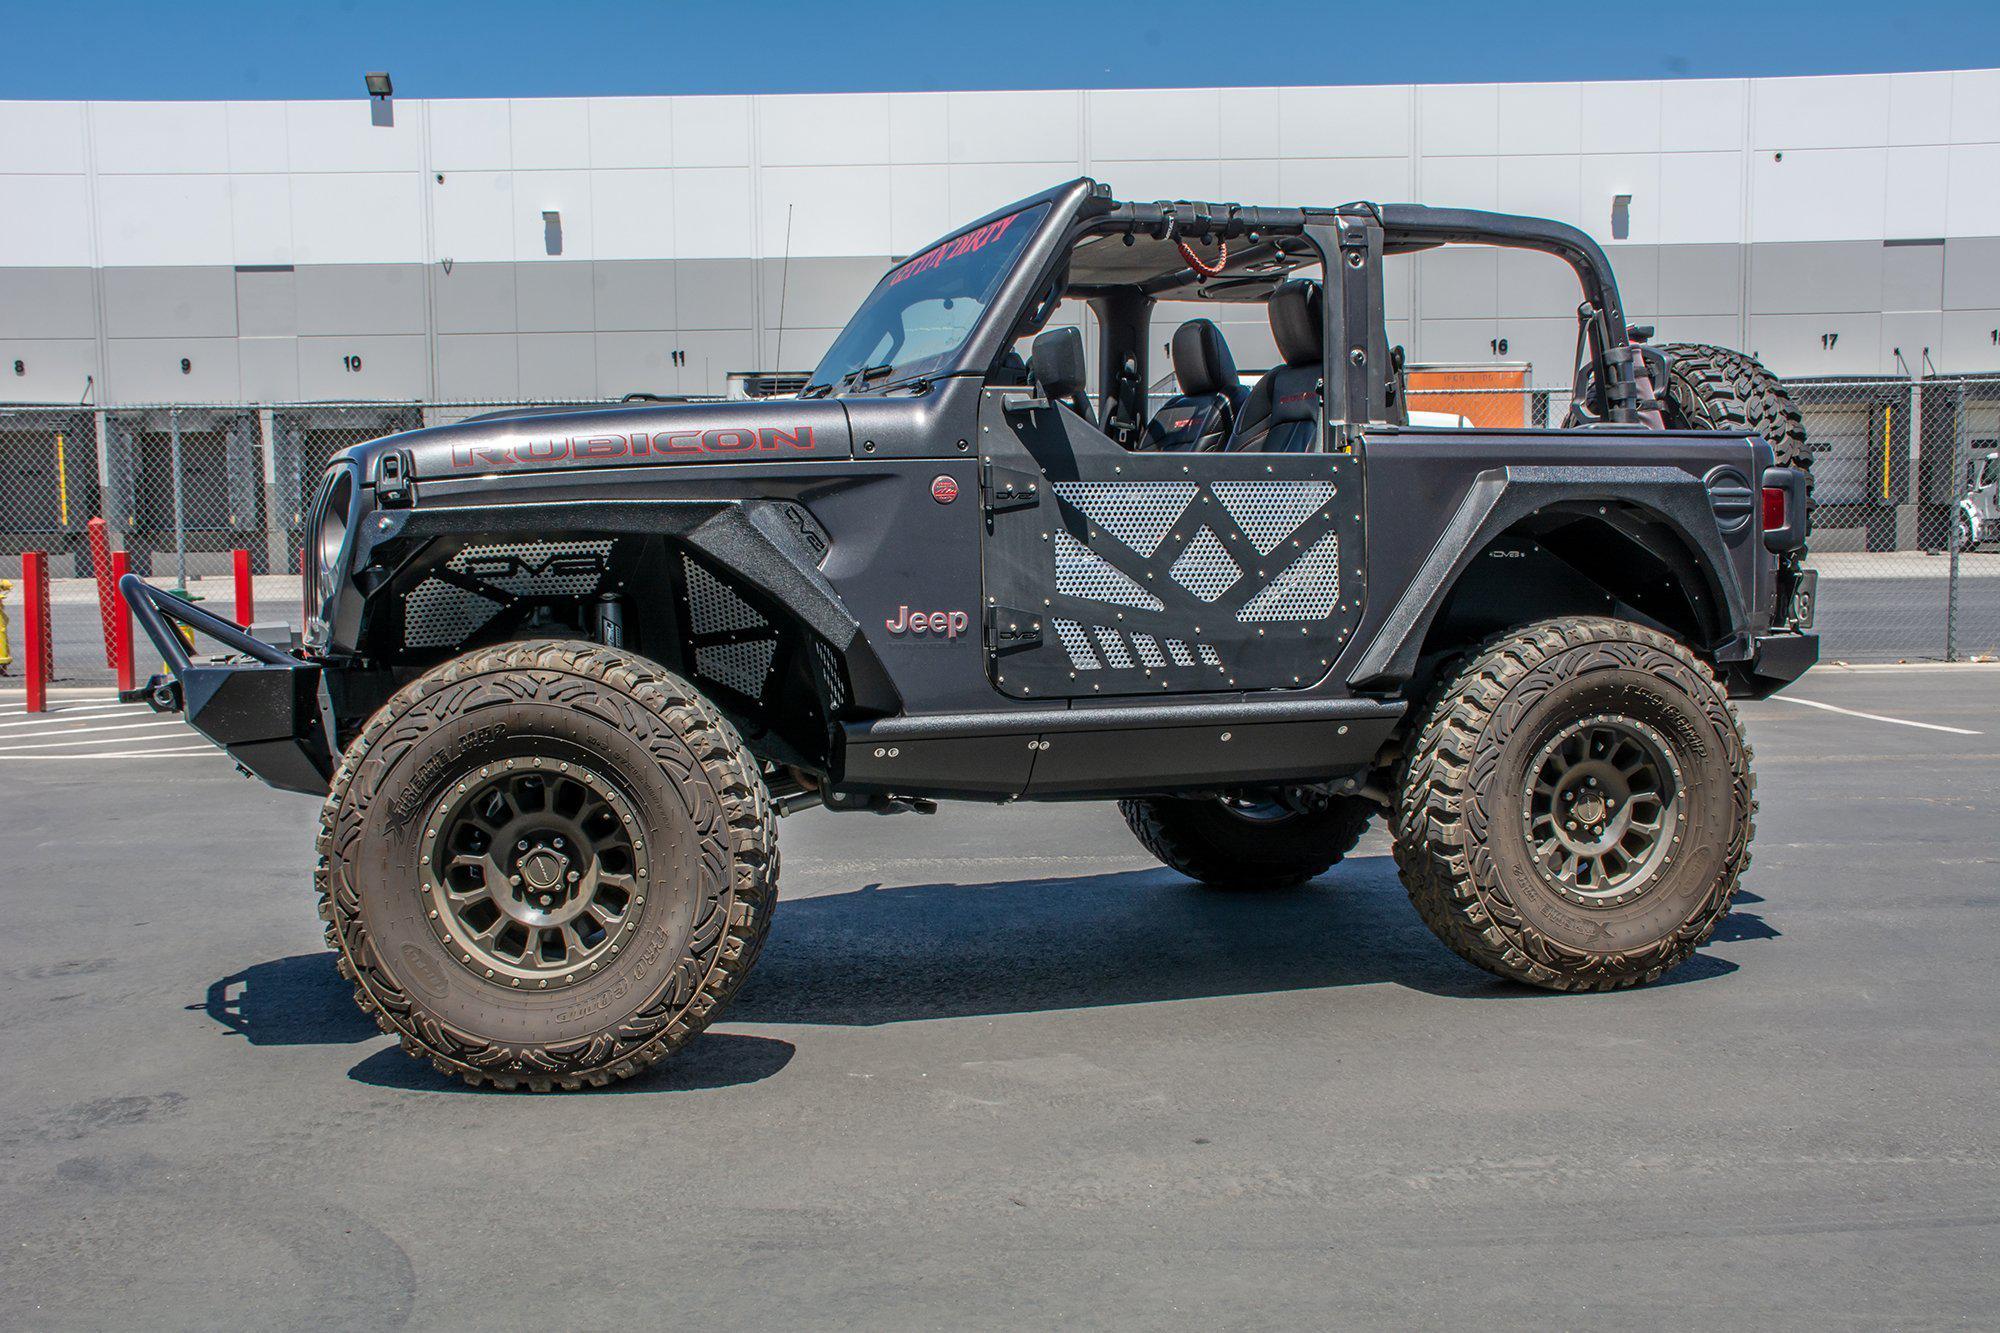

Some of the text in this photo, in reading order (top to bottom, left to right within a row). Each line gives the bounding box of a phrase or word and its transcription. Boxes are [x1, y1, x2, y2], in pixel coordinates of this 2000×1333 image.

[946, 213, 1020, 260] DIRTY
[1490, 338, 1509, 355] 16
[1821, 333, 1838, 350] 17
[181, 358, 191, 374] 9
[343, 355, 362, 372] 10
[672, 350, 685, 367] 11
[14, 360, 25, 376] 8
[451, 426, 815, 467] RUBICON
[885, 605, 969, 639] Jeep
